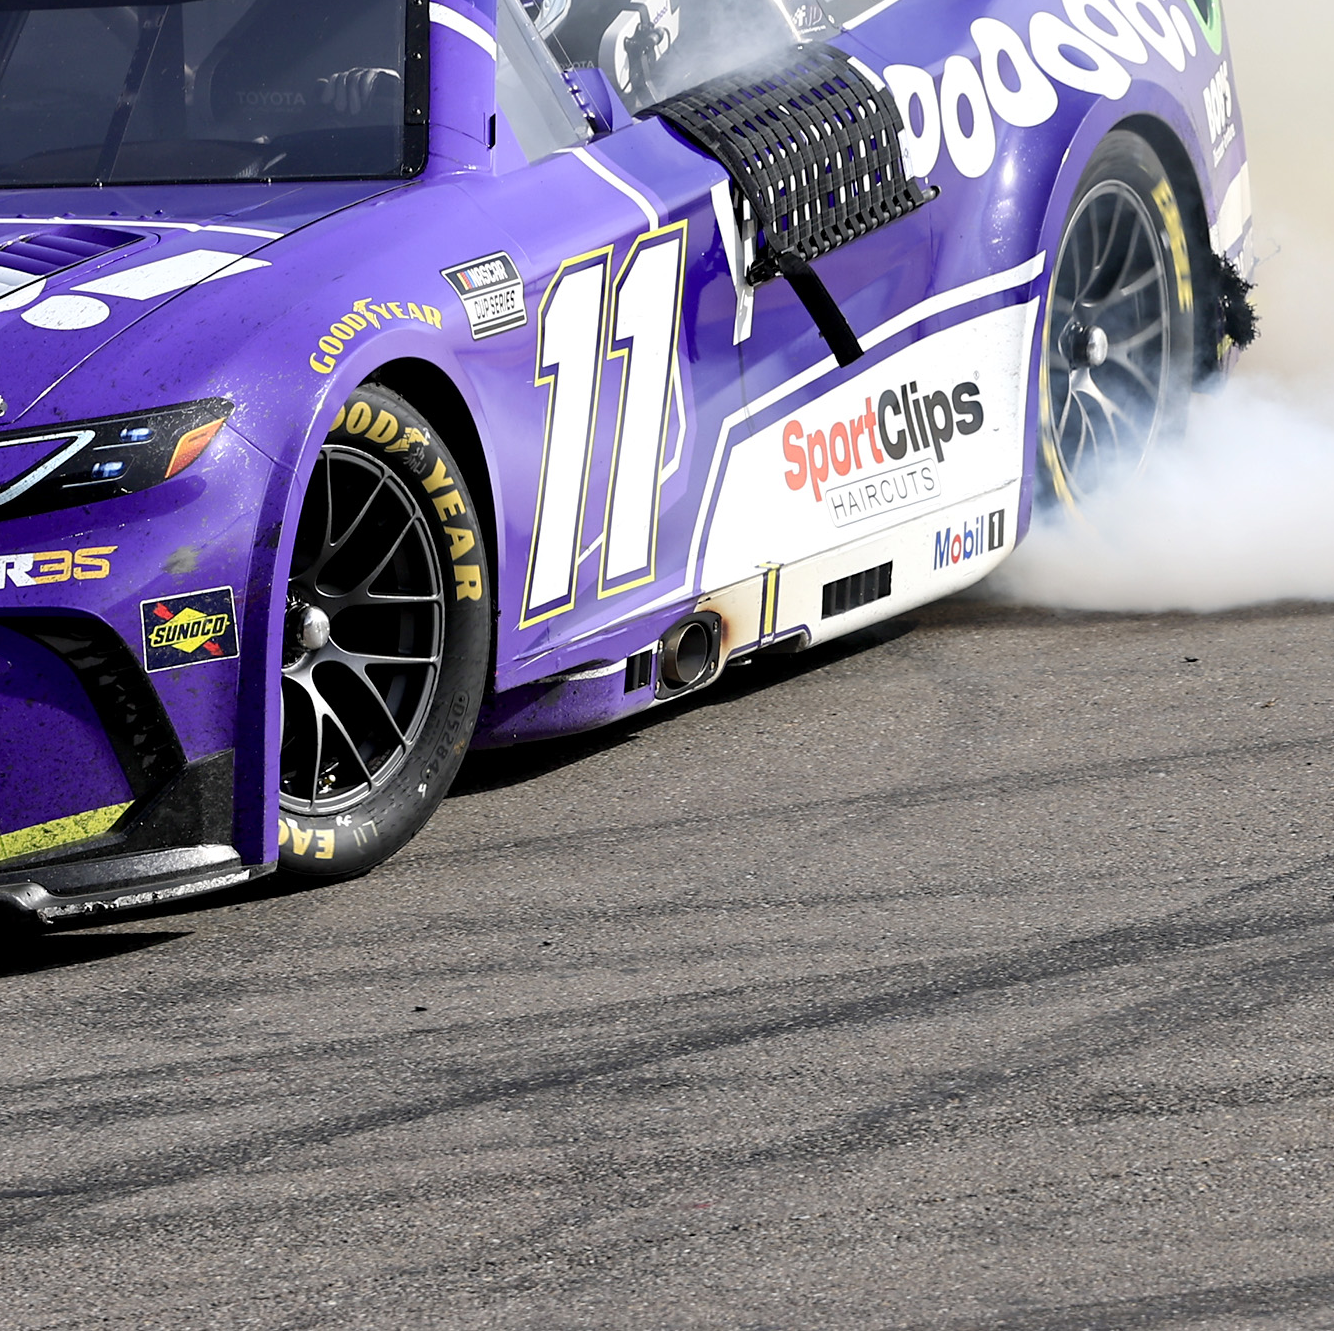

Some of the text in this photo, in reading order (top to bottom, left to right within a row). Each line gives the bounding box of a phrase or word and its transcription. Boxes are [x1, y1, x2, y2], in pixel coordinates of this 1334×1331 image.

[235, 91, 307, 106] TOYOTA
[467, 259, 509, 288] NASCAR
[473, 289, 516, 320] CUP SERIES
[310, 297, 443, 375] GOODYEAR
[519, 220, 688, 630] 11
[830, 467, 935, 520] HAIRCUTS
[933, 515, 984, 571] Mobil
[152, 613, 227, 648] SUNOCO
